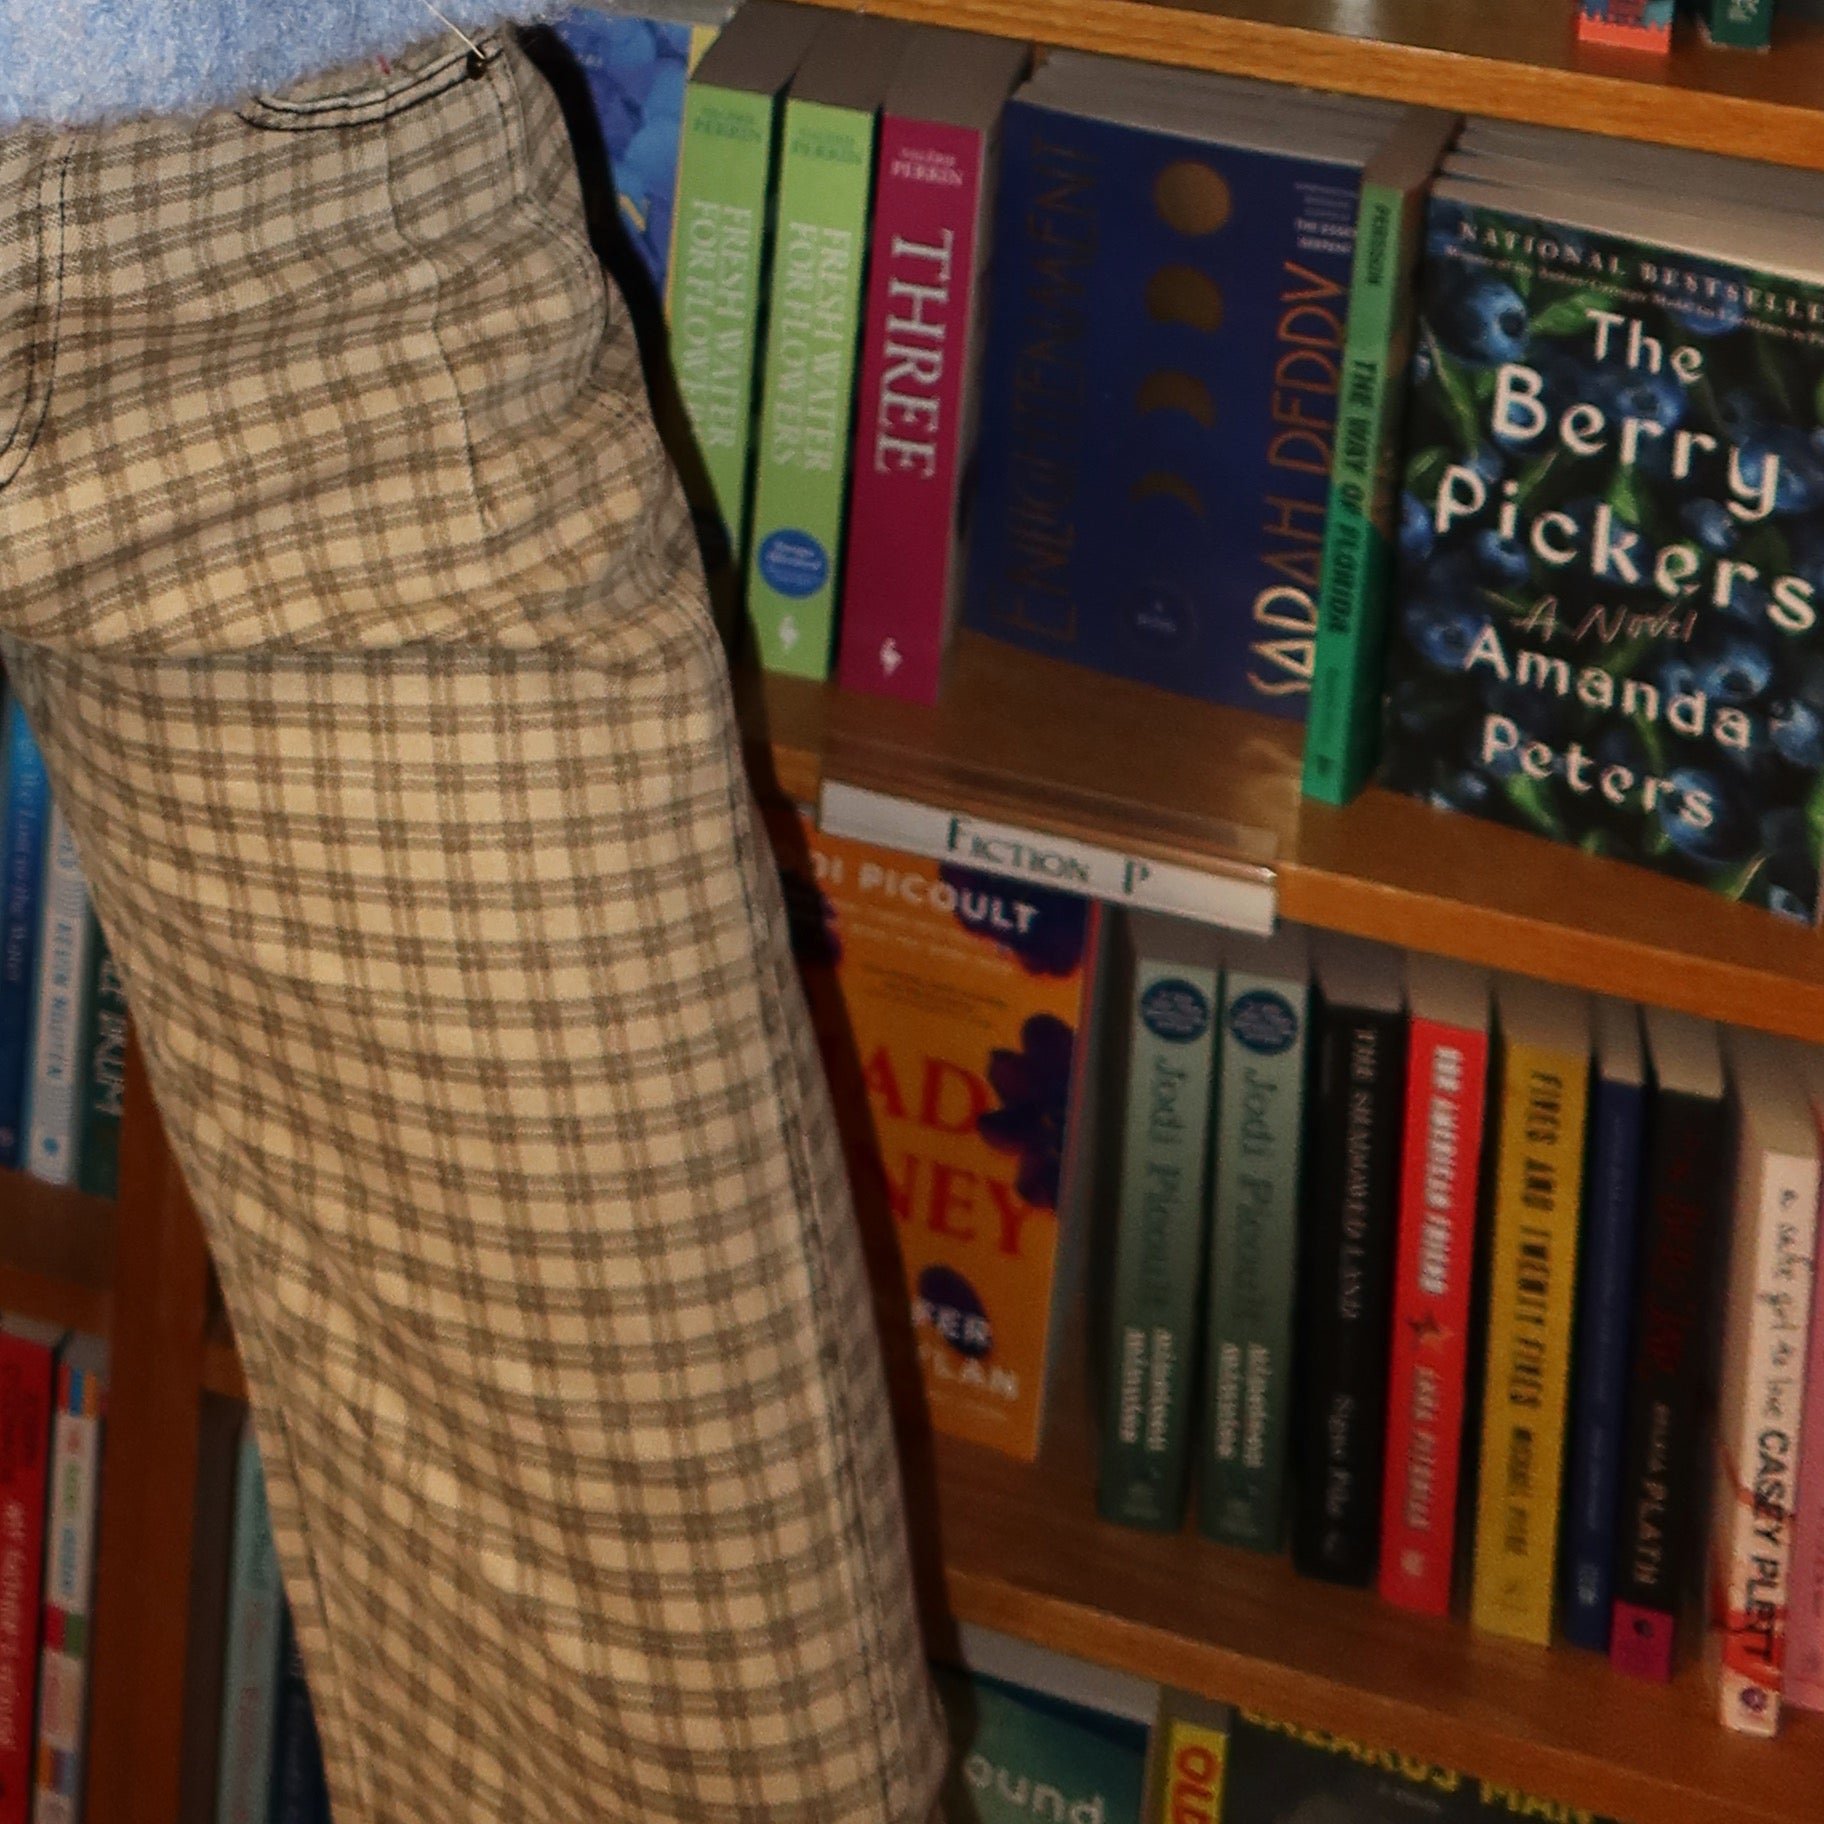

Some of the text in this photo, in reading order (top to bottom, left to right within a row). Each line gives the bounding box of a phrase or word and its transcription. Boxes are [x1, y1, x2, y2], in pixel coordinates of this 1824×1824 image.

[1459, 220, 1824, 325] NATIONAL BESTSELLE
[776, 222, 820, 467] FOR FLOWERS
[803, 227, 852, 472] FRESH WATER
[876, 228, 955, 478] THREE
[1585, 310, 1704, 381] The
[1490, 364, 1779, 522] Berry
[1434, 464, 1816, 635] Pickers
[1512, 598, 1696, 643] A Novel
[1464, 624, 1753, 751] Amanda
[1481, 713, 1716, 830] Peters
[860, 863, 1038, 937] PICOULT
[947, 816, 1150, 895] FICTION P
[1242, 1066, 1276, 1155] Jodi
[1744, 1429, 1790, 1664] CASEY PLETT
